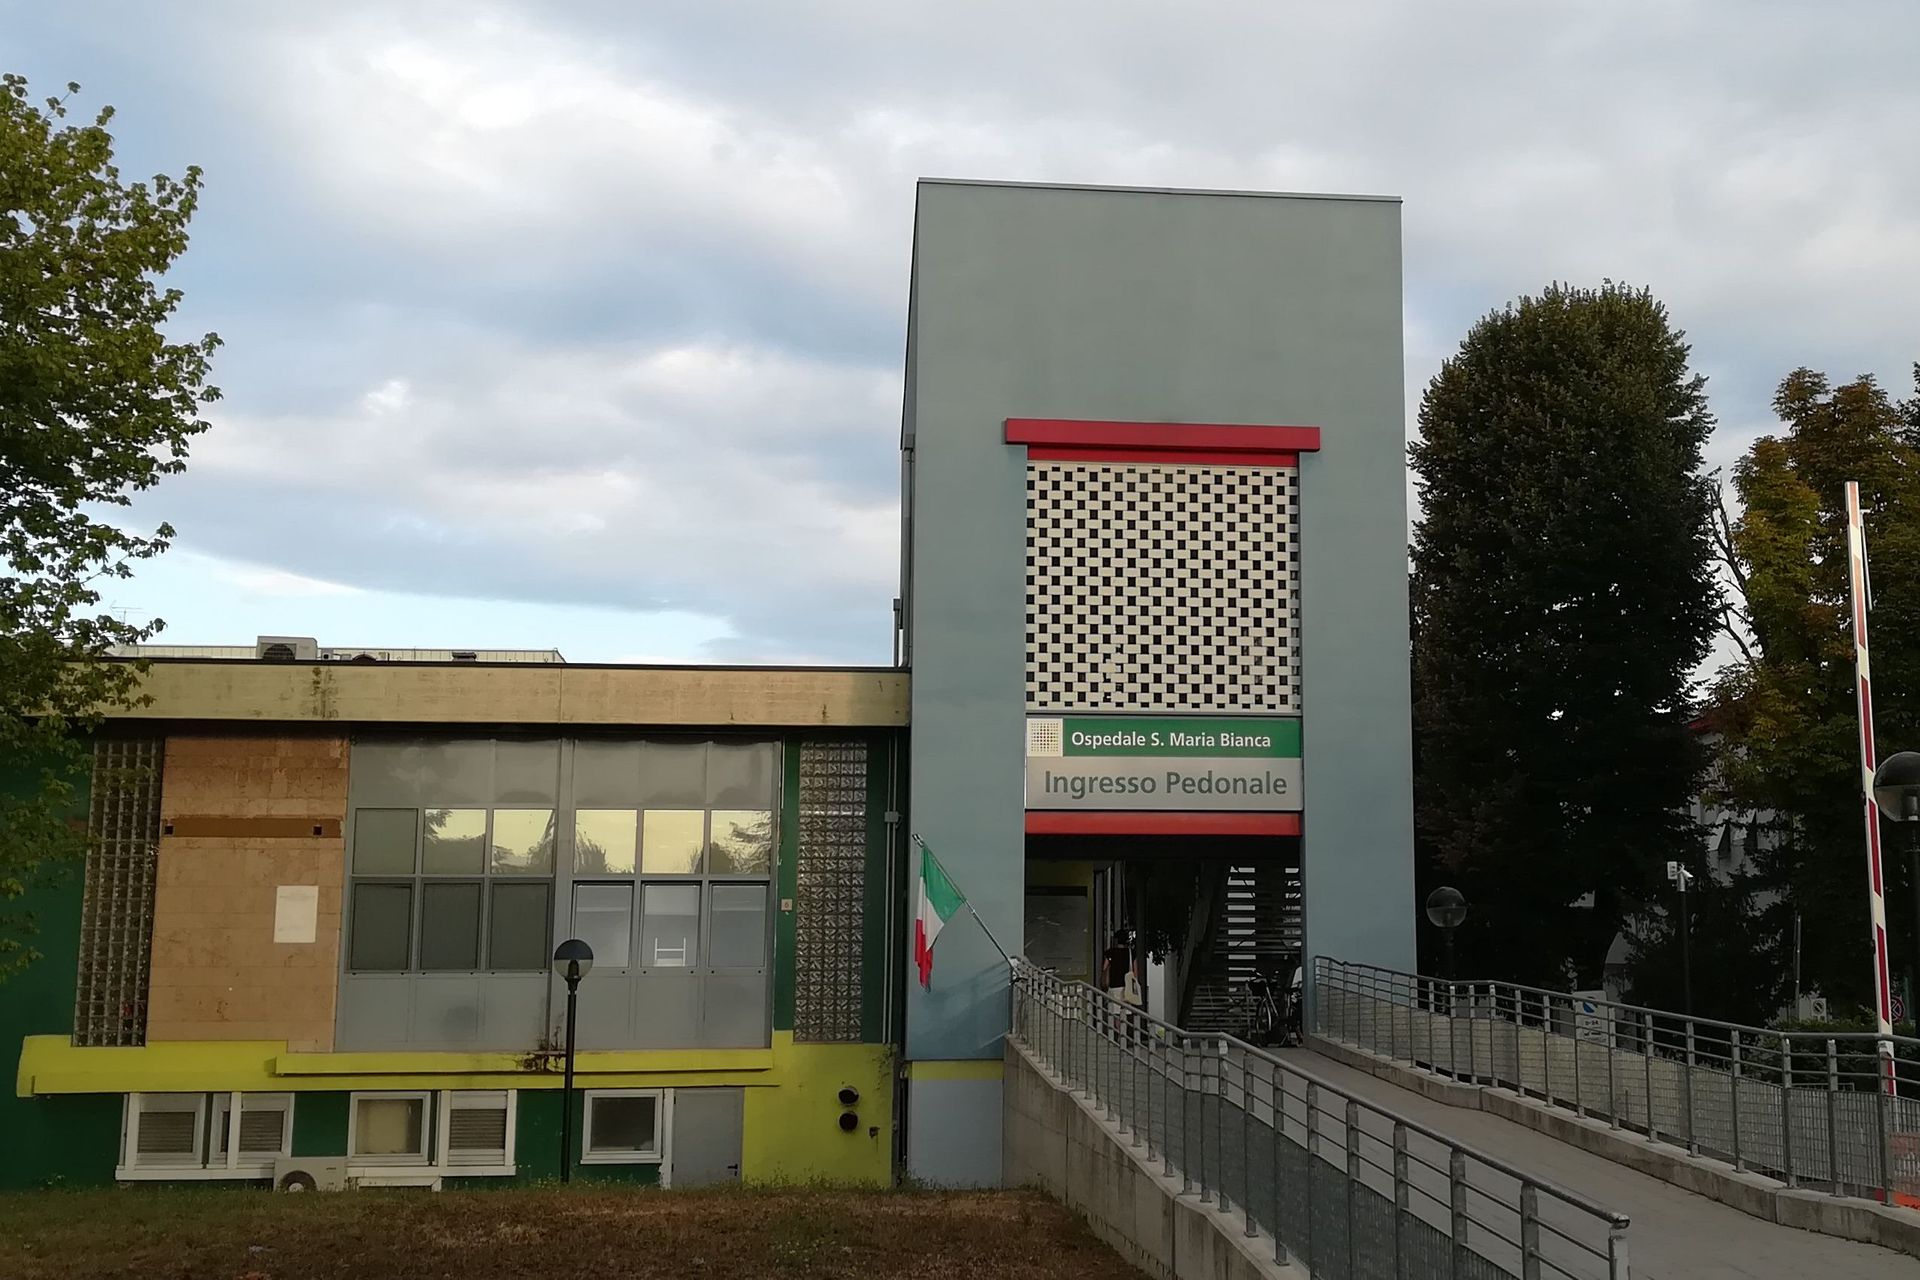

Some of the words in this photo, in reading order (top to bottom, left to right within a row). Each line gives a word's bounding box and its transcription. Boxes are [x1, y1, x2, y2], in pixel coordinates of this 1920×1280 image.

[1071, 731, 1146, 749] Ospedale
[1151, 732, 1165, 746] S.
[1170, 732, 1215, 747] Maria
[1220, 733, 1271, 748] Bianca
[1045, 770, 1157, 799] Ingresso
[1166, 770, 1287, 795] Pedonale
